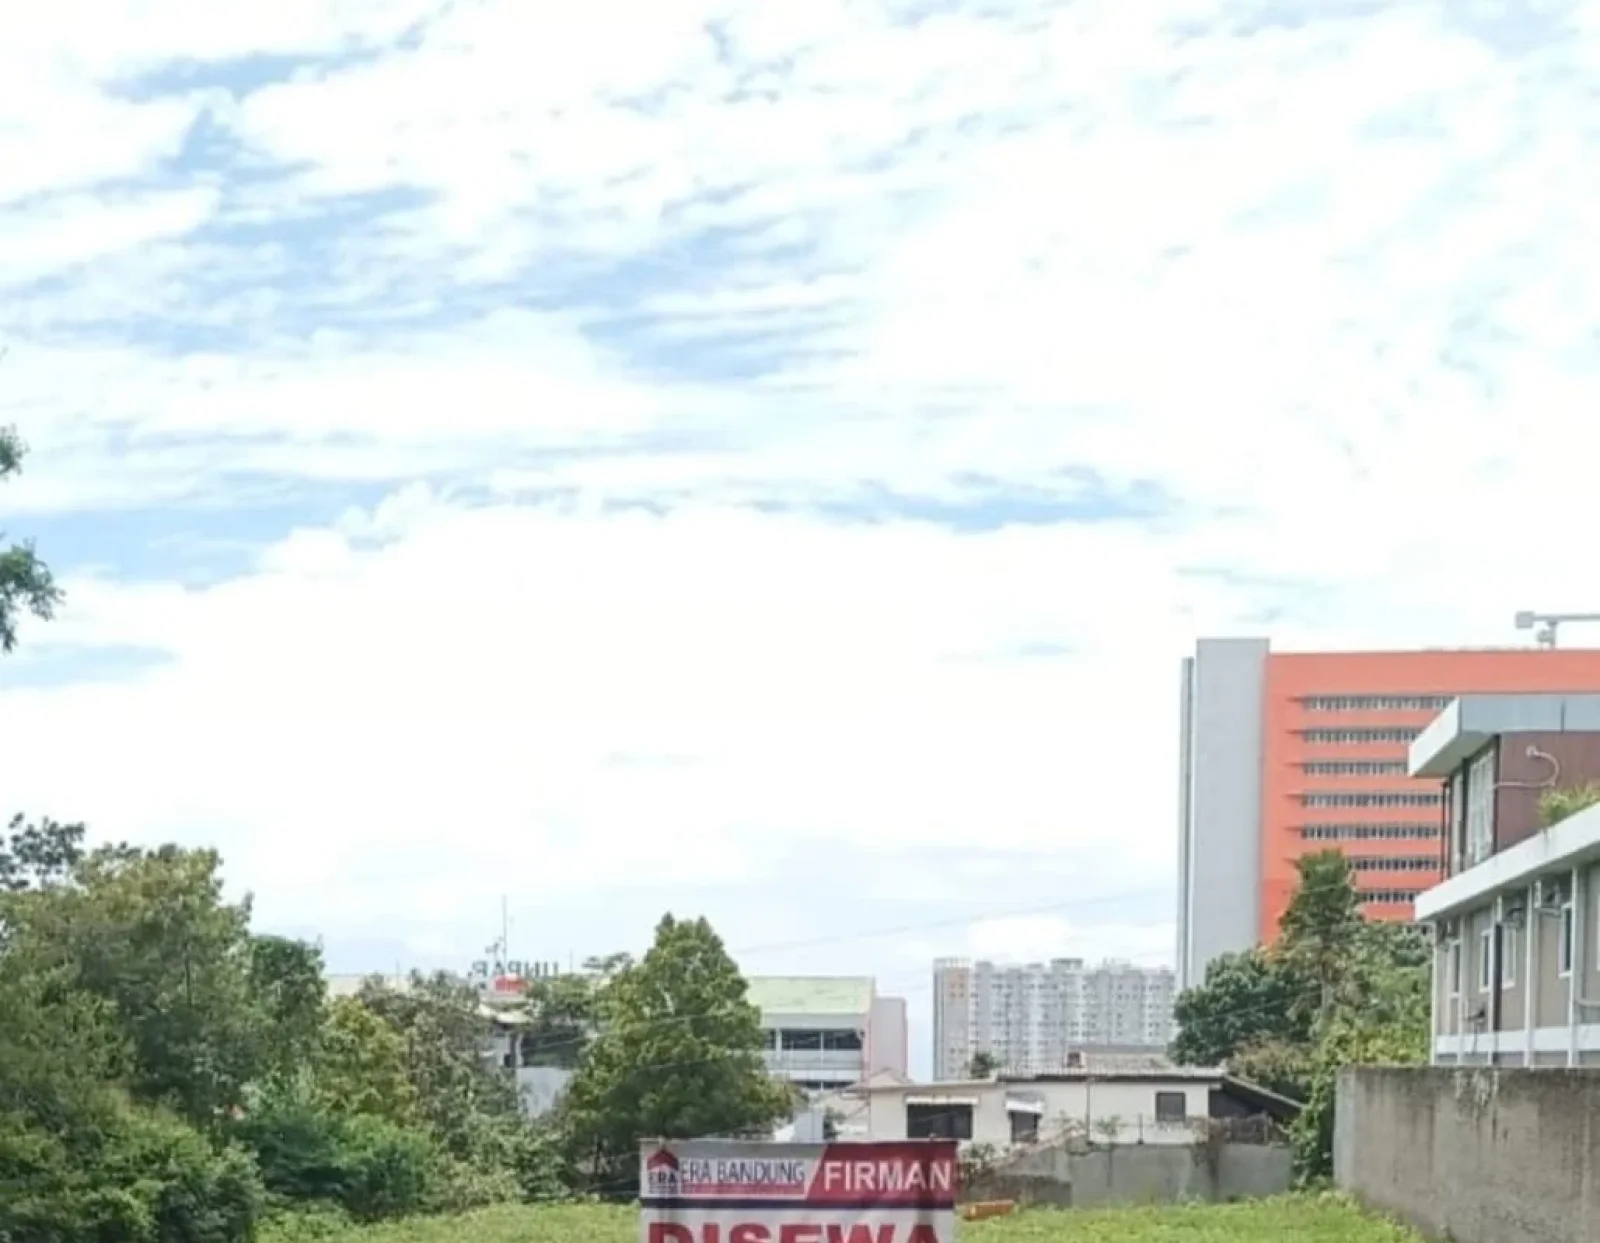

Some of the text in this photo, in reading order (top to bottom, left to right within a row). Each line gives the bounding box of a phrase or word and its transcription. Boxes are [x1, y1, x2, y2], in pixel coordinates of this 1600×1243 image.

[648, 1171, 678, 1184] ERA
[681, 1160, 805, 1182] ERA BANDUNG
[824, 1161, 950, 1191] FIRMAN
